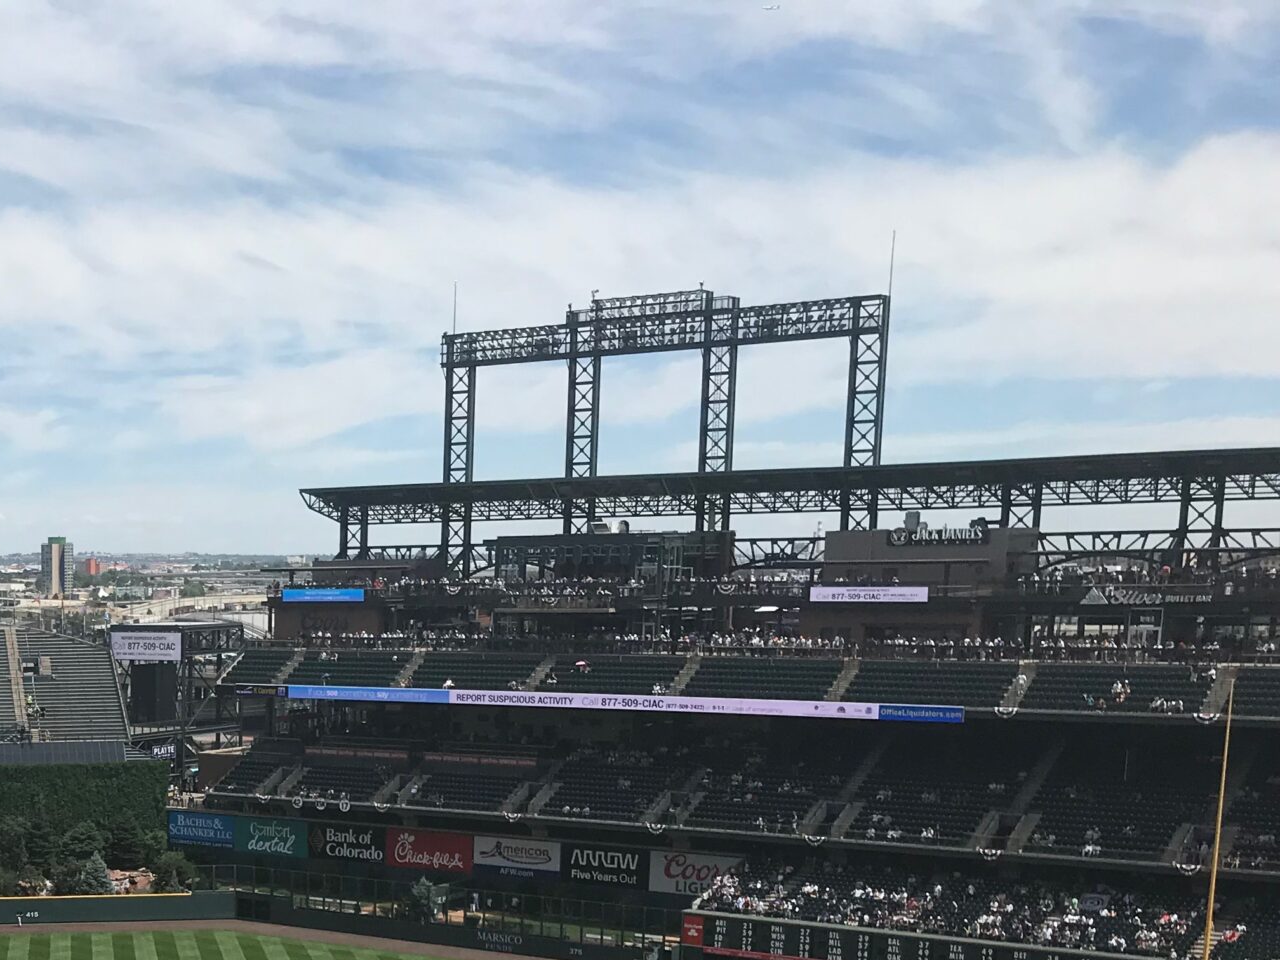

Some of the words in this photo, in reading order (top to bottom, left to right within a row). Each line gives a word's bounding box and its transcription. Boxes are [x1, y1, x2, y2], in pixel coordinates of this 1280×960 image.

[912, 526, 939, 540] JACK
[942, 525, 982, 539] DANIEL'S
[127, 642, 175, 650] 877-509-CIAC
[456, 694, 486, 702] REPORT
[488, 695, 536, 703] SUSPICIOUS
[538, 696, 574, 705] ACTIVITY
[601, 698, 664, 709] 877-509-CIAC
[213, 818, 223, 829] &
[326, 828, 357, 843] Bank
[359, 830, 373, 844] of
[248, 834, 295, 854] dental
[326, 842, 383, 860] Colorado
[395, 839, 463, 868] Chick-fil-A
[571, 849, 638, 869] ARROW
[571, 869, 591, 879] Five
[592, 870, 618, 882] Years
[619, 873, 637, 884] Out
[477, 930, 522, 945] MARSICO
